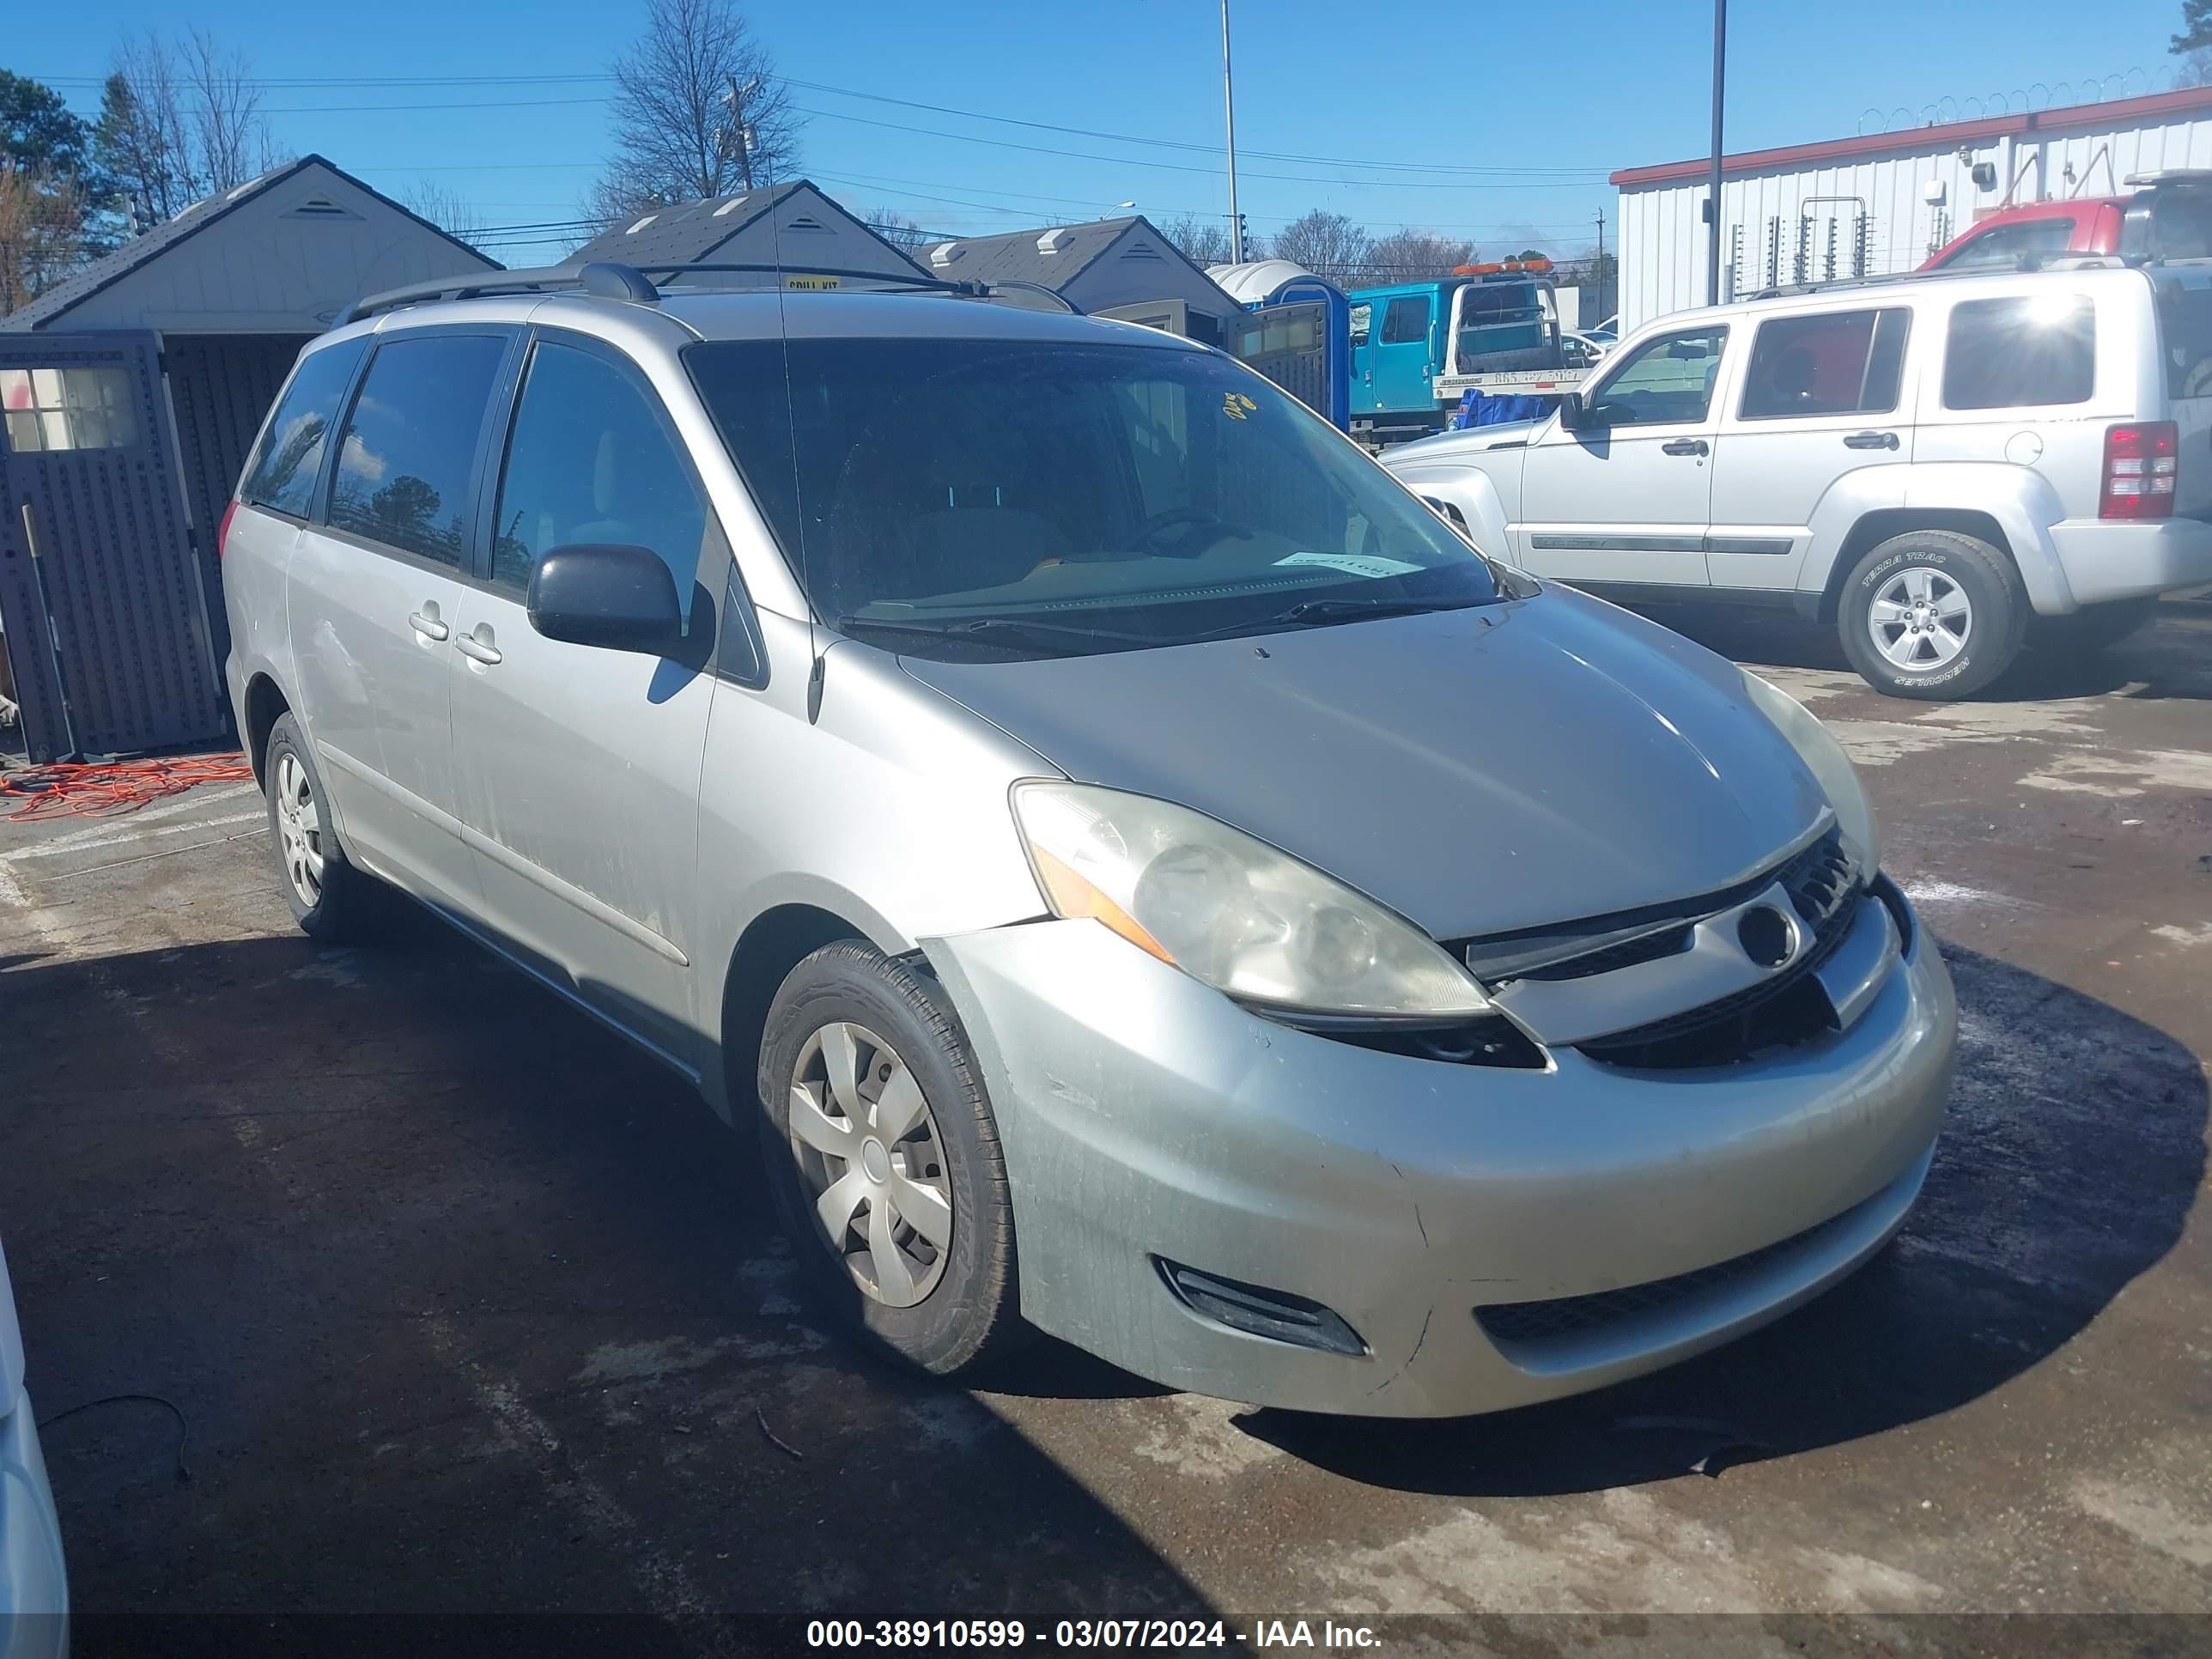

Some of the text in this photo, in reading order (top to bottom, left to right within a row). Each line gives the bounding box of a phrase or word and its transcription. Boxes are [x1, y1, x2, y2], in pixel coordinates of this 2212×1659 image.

[1862, 551, 1947, 587] TERRA TRAC
[1894, 657, 1970, 686] HERCULES
